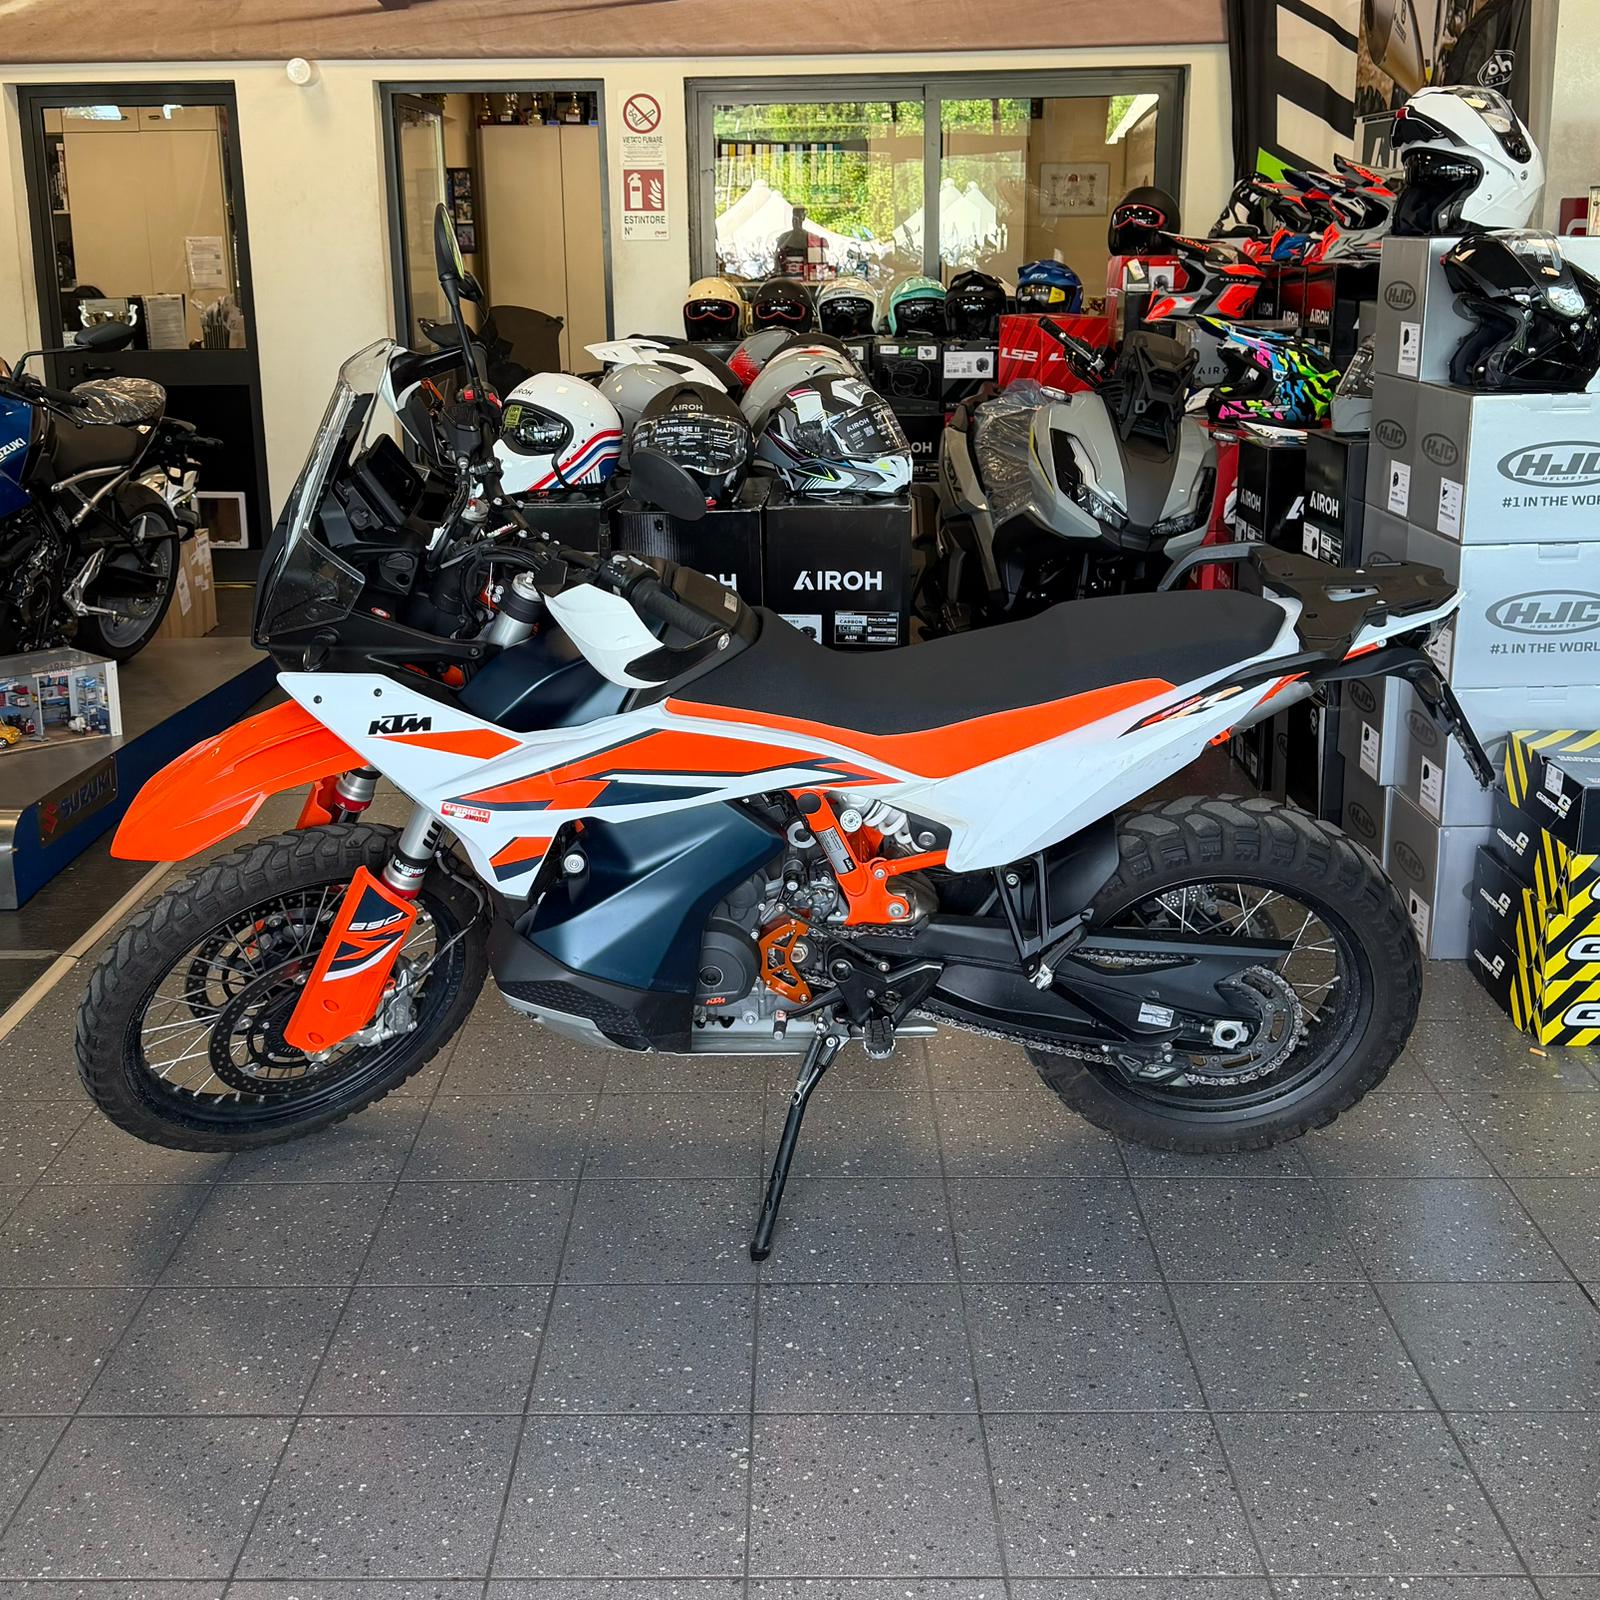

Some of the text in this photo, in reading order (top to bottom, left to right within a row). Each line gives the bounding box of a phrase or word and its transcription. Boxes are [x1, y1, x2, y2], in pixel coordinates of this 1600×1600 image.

[624, 215, 666, 225] ESTINTORE
[1388, 287, 1413, 305] HJC
[1310, 307, 1330, 326] AIROH
[1001, 347, 1038, 362] LS2
[671, 403, 703, 412] AIROH
[656, 426, 693, 434] MATHISSE
[846, 417, 870, 433] AIROH
[1426, 439, 1454, 460] HJC
[1240, 488, 1261, 512] AIROH
[1309, 490, 1339, 518] AIROH
[1502, 496, 1520, 508] #1
[1523, 496, 1538, 507] IN
[1540, 495, 1568, 506] THE
[793, 570, 883, 591] AIROH
[1502, 601, 1600, 624] HJC
[1490, 643, 1508, 654] #1
[1511, 643, 1526, 654] IN
[1528, 642, 1556, 653] THE
[368, 713, 432, 735] KTM
[60, 768, 113, 820] SUZUKI
[443, 804, 489, 817] GABRIELLI
[348, 912, 404, 930] 890
